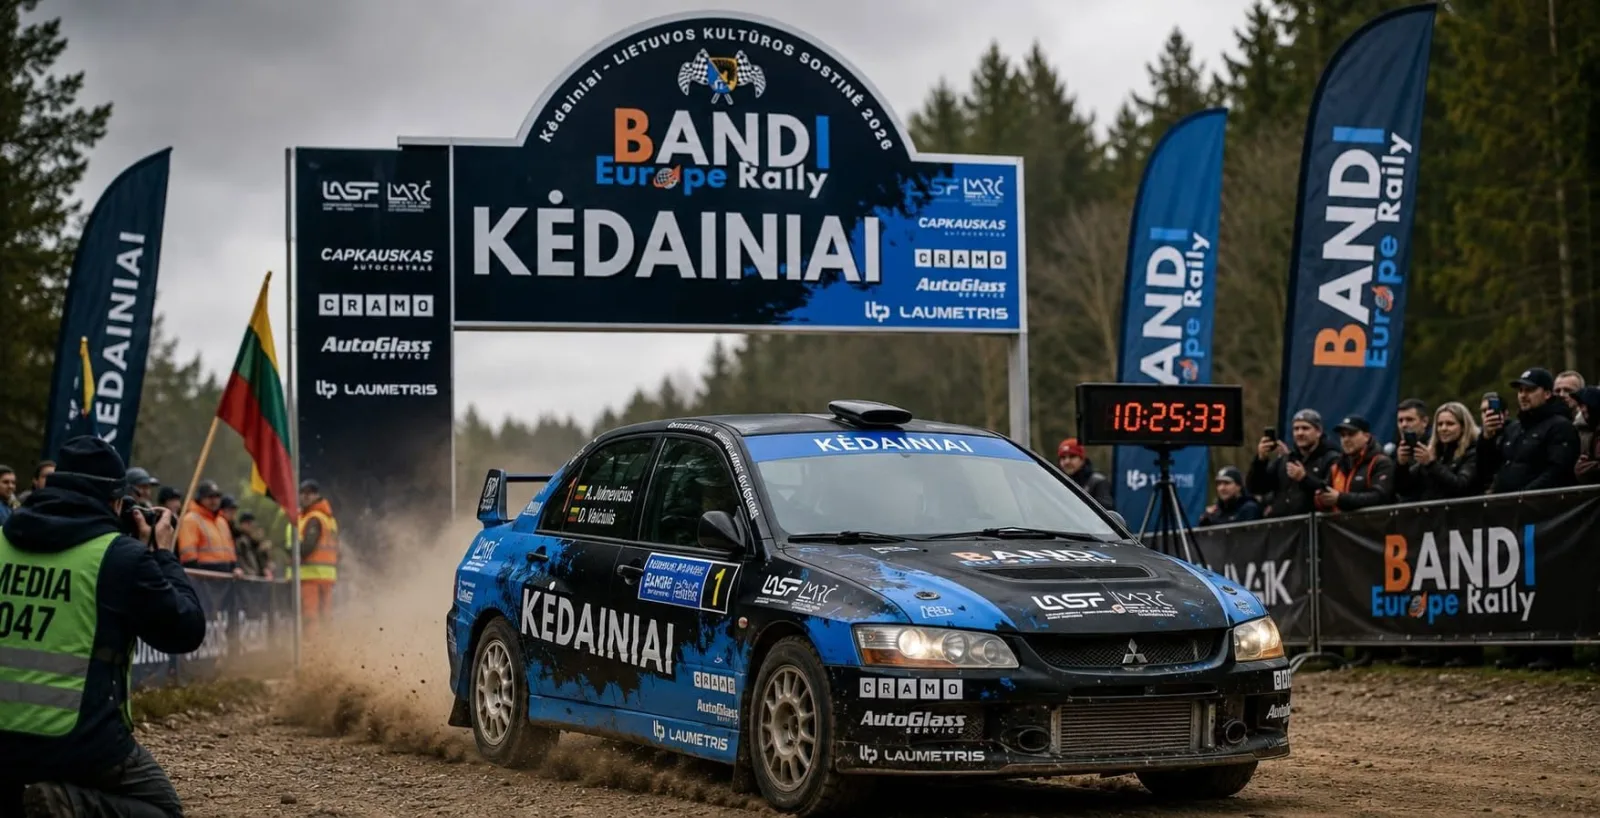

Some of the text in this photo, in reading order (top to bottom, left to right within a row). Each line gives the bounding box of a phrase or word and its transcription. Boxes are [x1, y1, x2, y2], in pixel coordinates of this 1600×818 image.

[538, 69, 602, 143] Kėdainiai
[613, 28, 696, 65] LIETUVOS
[703, 27, 795, 57] KULTŪROS
[799, 52, 865, 107] SOSTINĖ
[861, 108, 893, 150] 2026
[614, 107, 830, 170] BANDI
[738, 160, 829, 199] Rally
[918, 217, 1007, 230] CAPKAUSKAS
[473, 189, 881, 283] KĖDAINIAI
[320, 247, 434, 263] CAPKAUSKAS
[1313, 126, 1385, 367] BANDI
[917, 250, 1004, 267] CRAMO
[916, 277, 1007, 293] AutoGlass
[321, 296, 432, 314] CRAMO
[900, 305, 1009, 320] LAUMETRIS
[1140, 227, 1188, 385] ANDI
[321, 336, 433, 353] AutoGlass
[372, 352, 430, 360] SERVICE
[344, 383, 438, 396] LAUMETRIS
[1113, 402, 1226, 433] 10:25:33
[813, 434, 974, 453] KĖDAINIAI
[1384, 524, 1536, 592] BANDI
[711, 567, 727, 607] 1
[1466, 581, 1536, 622] Rally
[520, 581, 674, 675] KĖDAINIAI
[861, 680, 961, 697] CRAMO
[860, 710, 967, 727] AutoGlass
[668, 728, 729, 751] LAUMETRIS
[905, 727, 965, 735] SERVICE
[884, 750, 986, 762] LAUMETRIS
